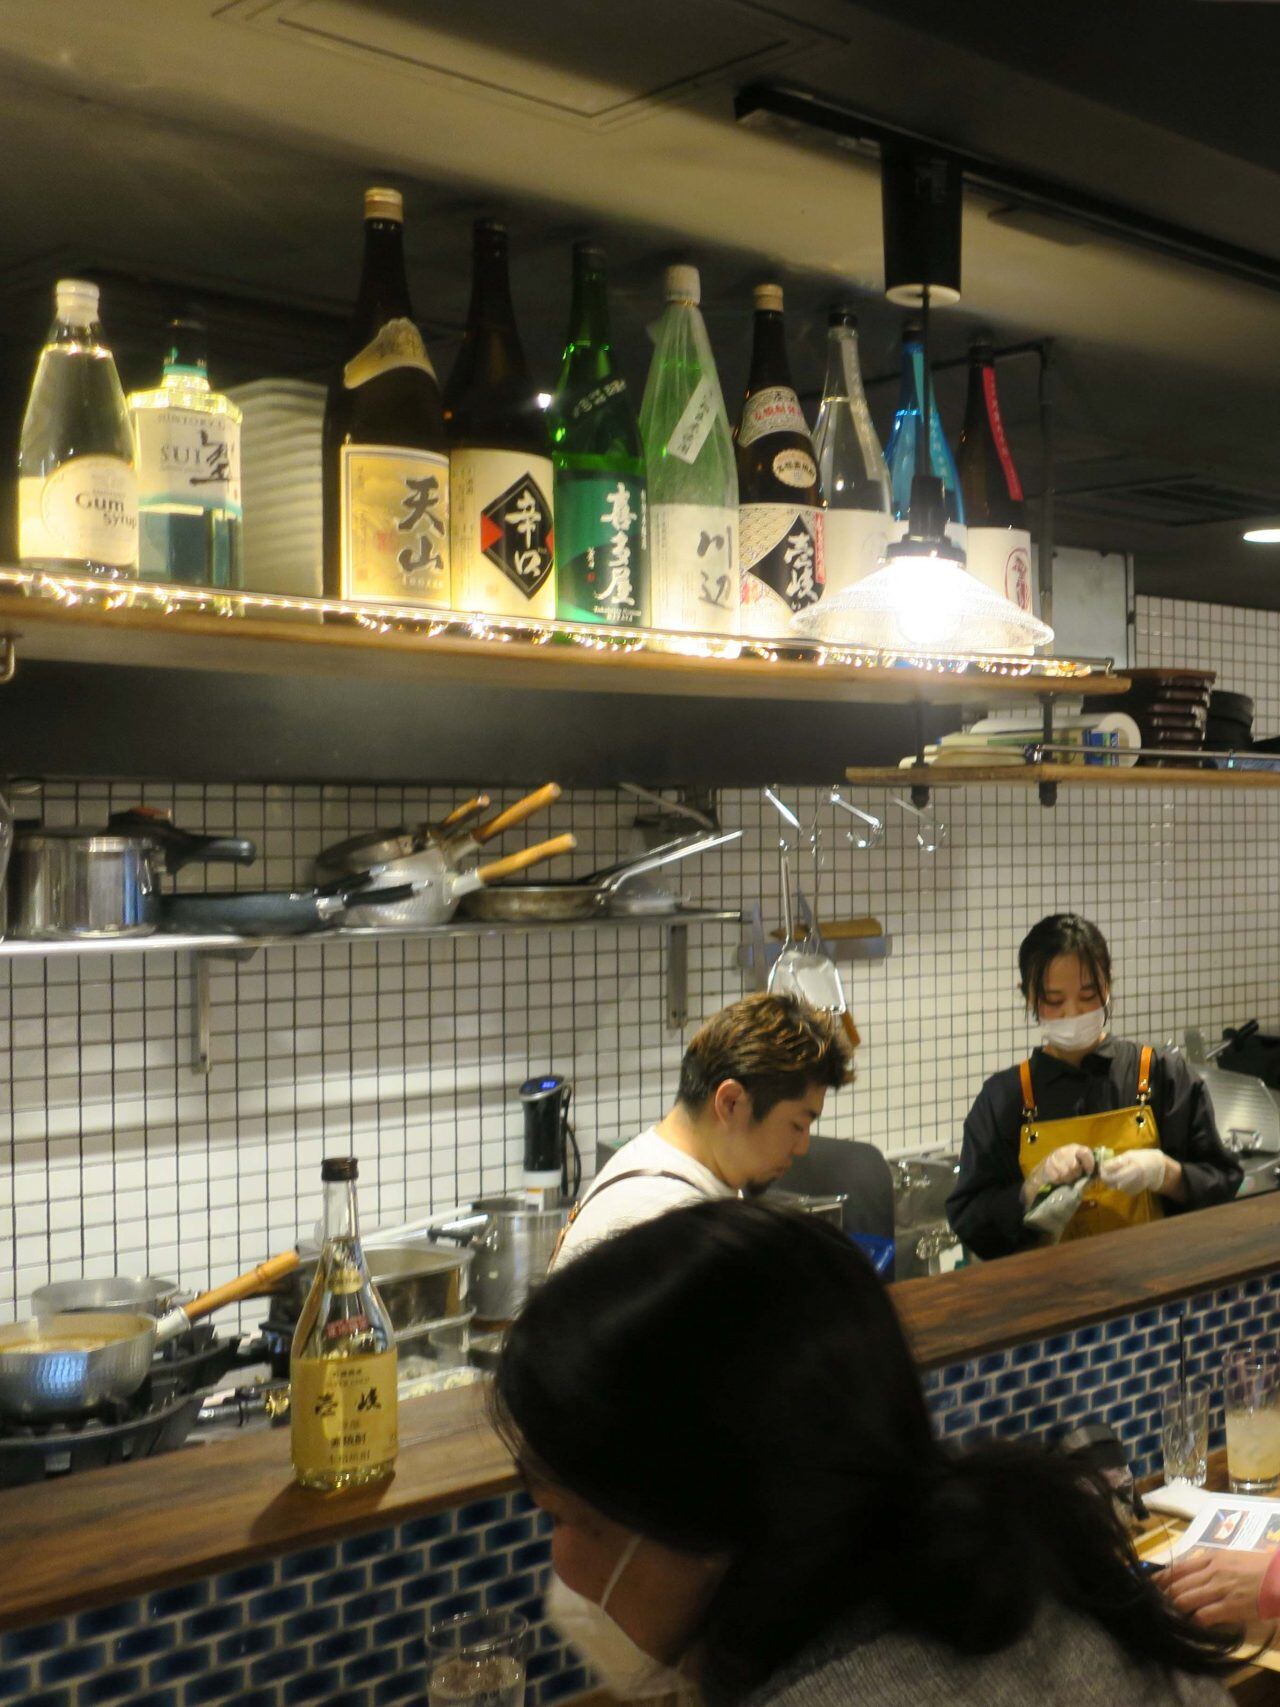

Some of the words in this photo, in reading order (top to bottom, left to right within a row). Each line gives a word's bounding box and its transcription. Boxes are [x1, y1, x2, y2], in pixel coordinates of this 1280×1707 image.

[161, 445, 200, 464] SUI
[75, 492, 124, 512] Gum
[397, 475, 446, 573] 天山
[504, 489, 542, 577] 辛口
